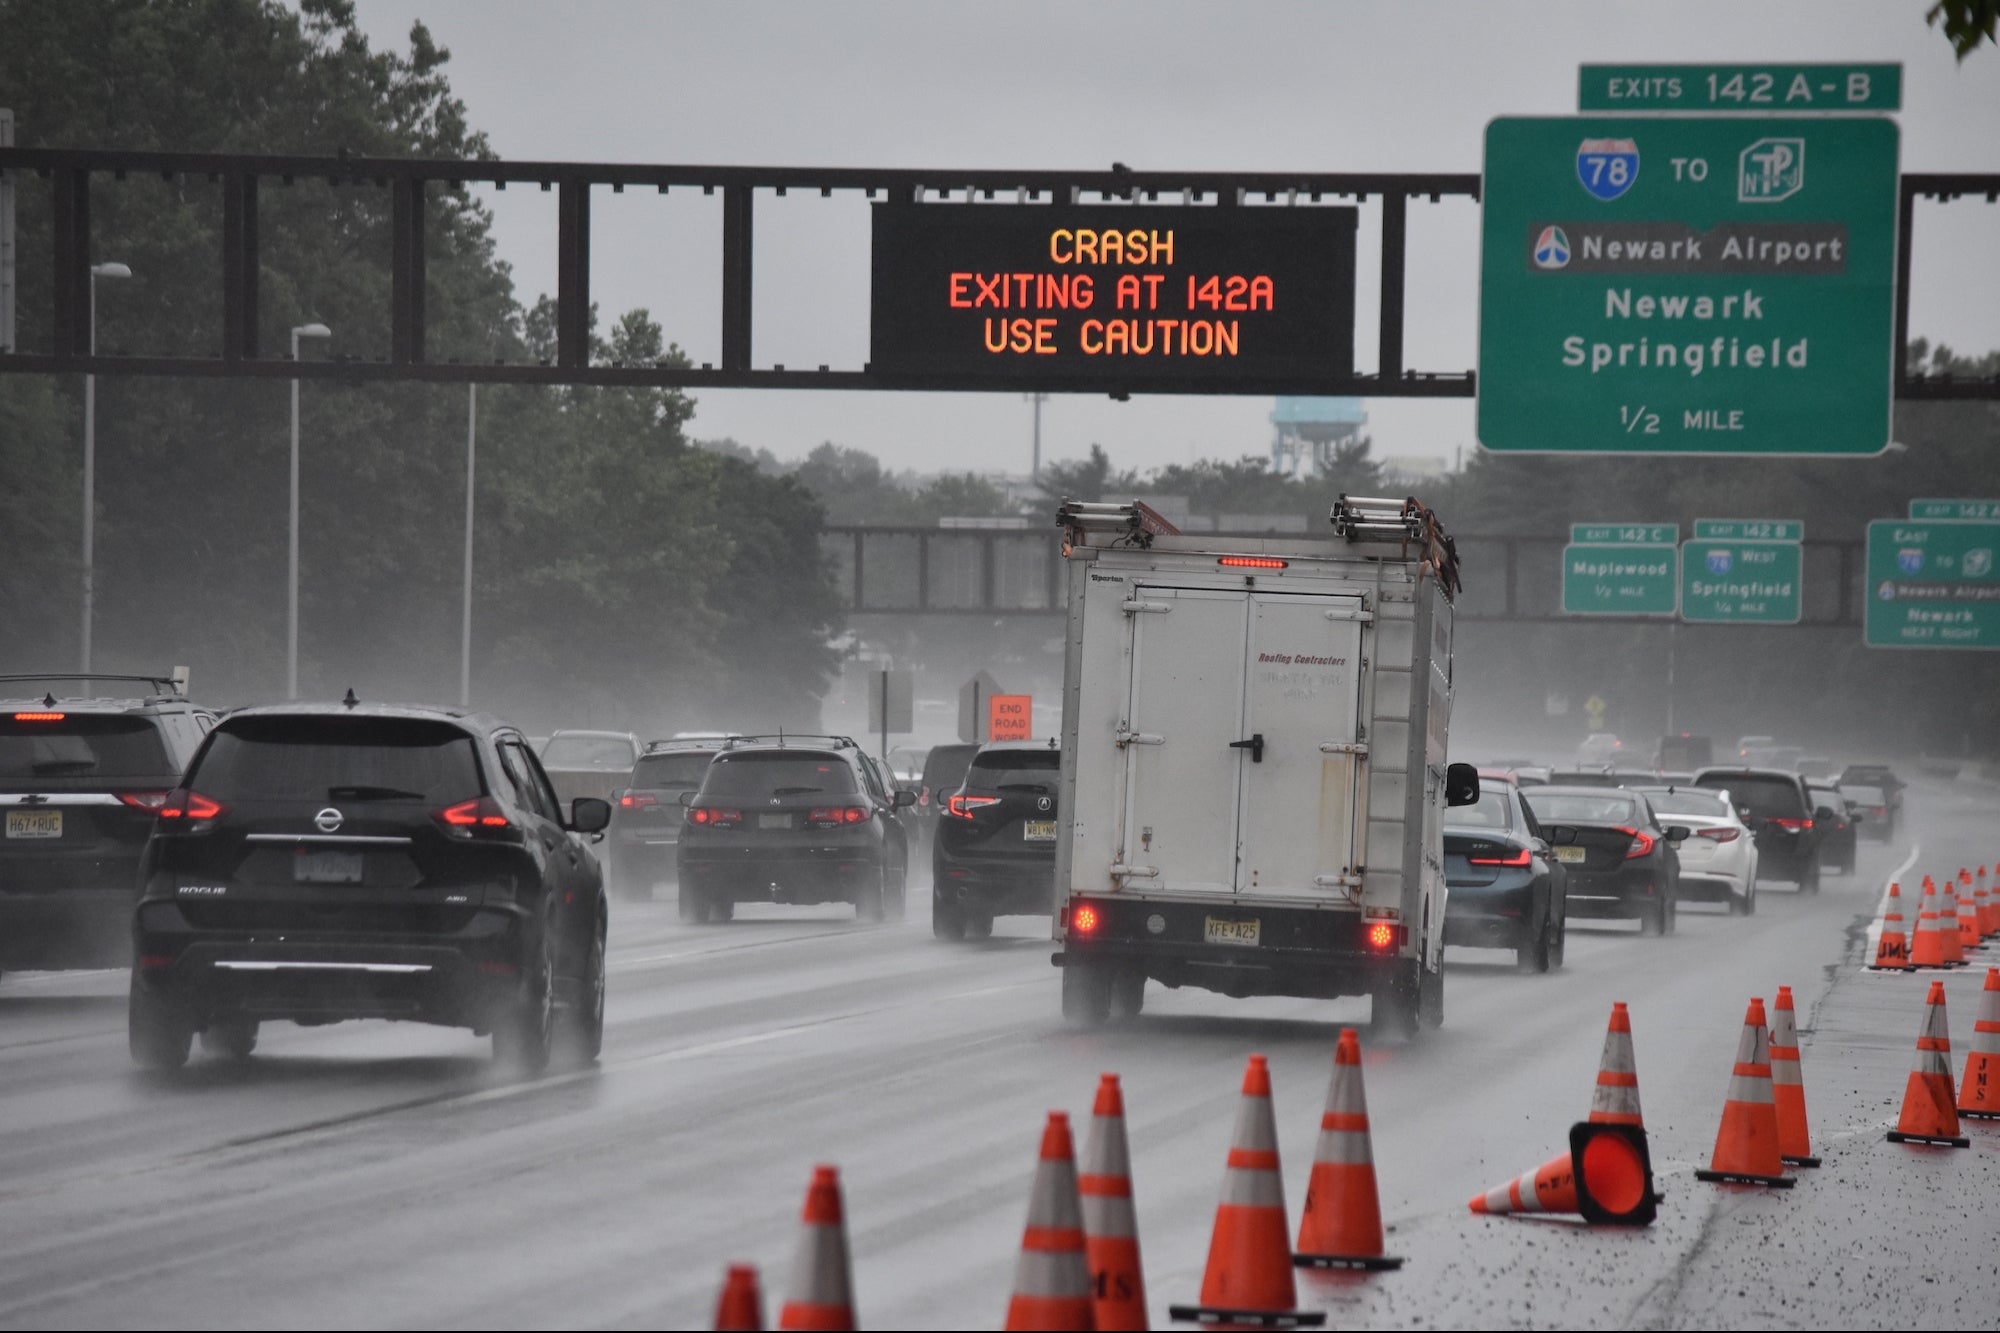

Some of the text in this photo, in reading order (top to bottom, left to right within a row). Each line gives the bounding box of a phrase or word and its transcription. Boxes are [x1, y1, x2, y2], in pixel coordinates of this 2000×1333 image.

[1607, 77, 1682, 99] EXITS
[1708, 73, 1774, 102] 142
[1587, 157, 1709, 187] 78 TO
[1050, 229, 1174, 265] CRASH
[1583, 235, 1842, 265] Newark Airport
[950, 273, 1274, 311] EXITING AT 142A
[1606, 288, 1764, 319] Newark
[985, 318, 1239, 356] USE CAUTION
[1562, 336, 1808, 376] Springfield
[1683, 410, 1745, 430] MILE
[1618, 528, 1646, 542] 142
[1652, 528, 1662, 541] C
[1743, 525, 1770, 538] 142
[1573, 562, 1667, 577] Maplewood
[1692, 581, 1792, 599] Springfield
[1908, 607, 1973, 622] Newark
[1259, 653, 1346, 666] Roofing Contractors
[1000, 704, 1022, 713] END
[995, 719, 1026, 728] ROAD
[1208, 921, 1257, 939] XFE A25
